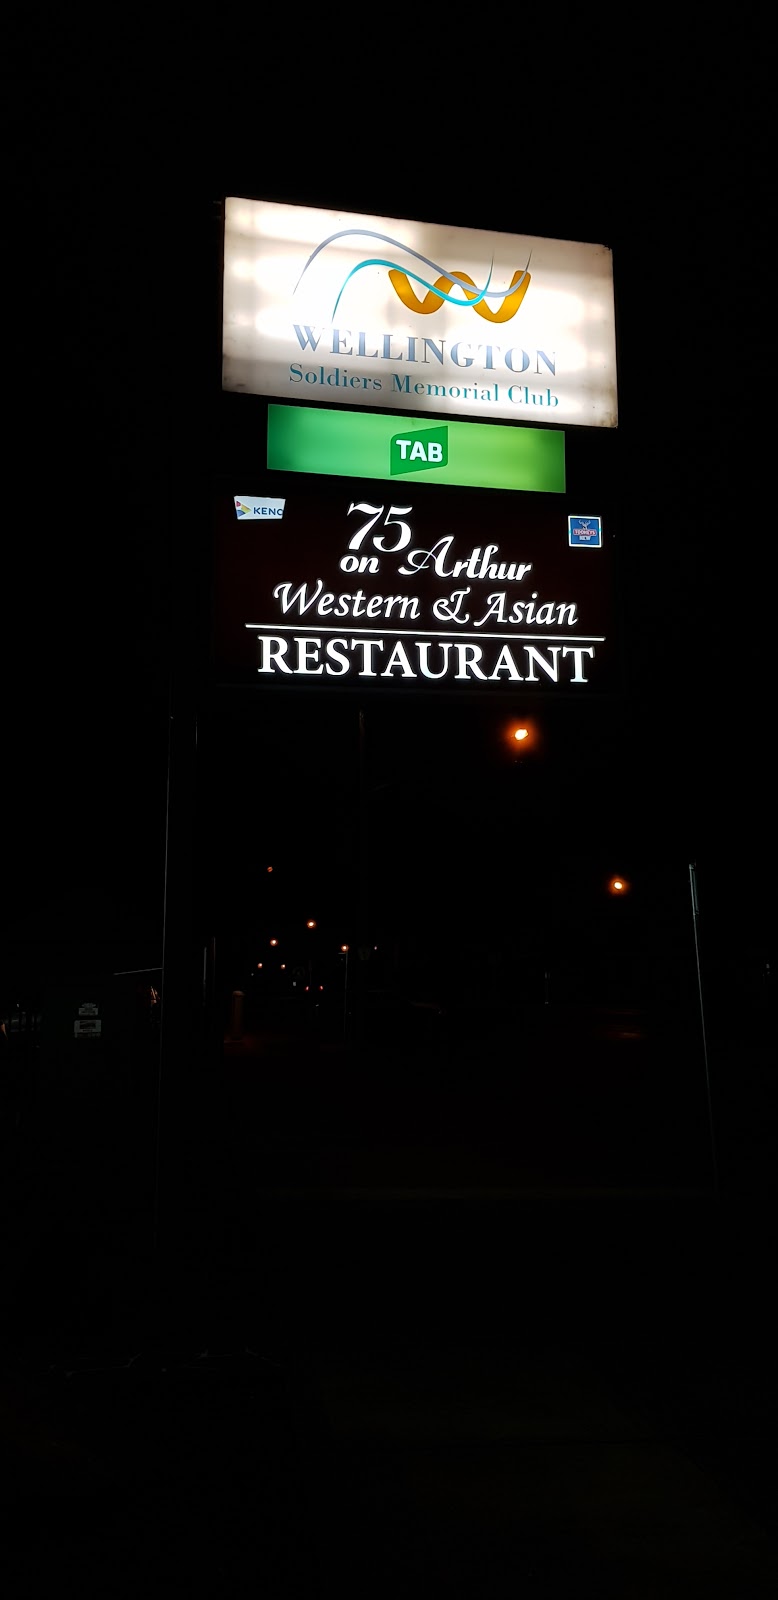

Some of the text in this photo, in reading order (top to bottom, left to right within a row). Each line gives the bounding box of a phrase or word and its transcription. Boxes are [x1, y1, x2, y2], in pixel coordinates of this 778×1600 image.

[292, 324, 557, 376] WELLINGTON
[289, 362, 559, 408] Soldiers Memorial Club
[396, 439, 444, 463] TAB
[347, 502, 413, 552] 75
[340, 535, 532, 581] on Arthur
[273, 579, 578, 627] Western & Asian
[257, 635, 594, 683] RESTAURANT
